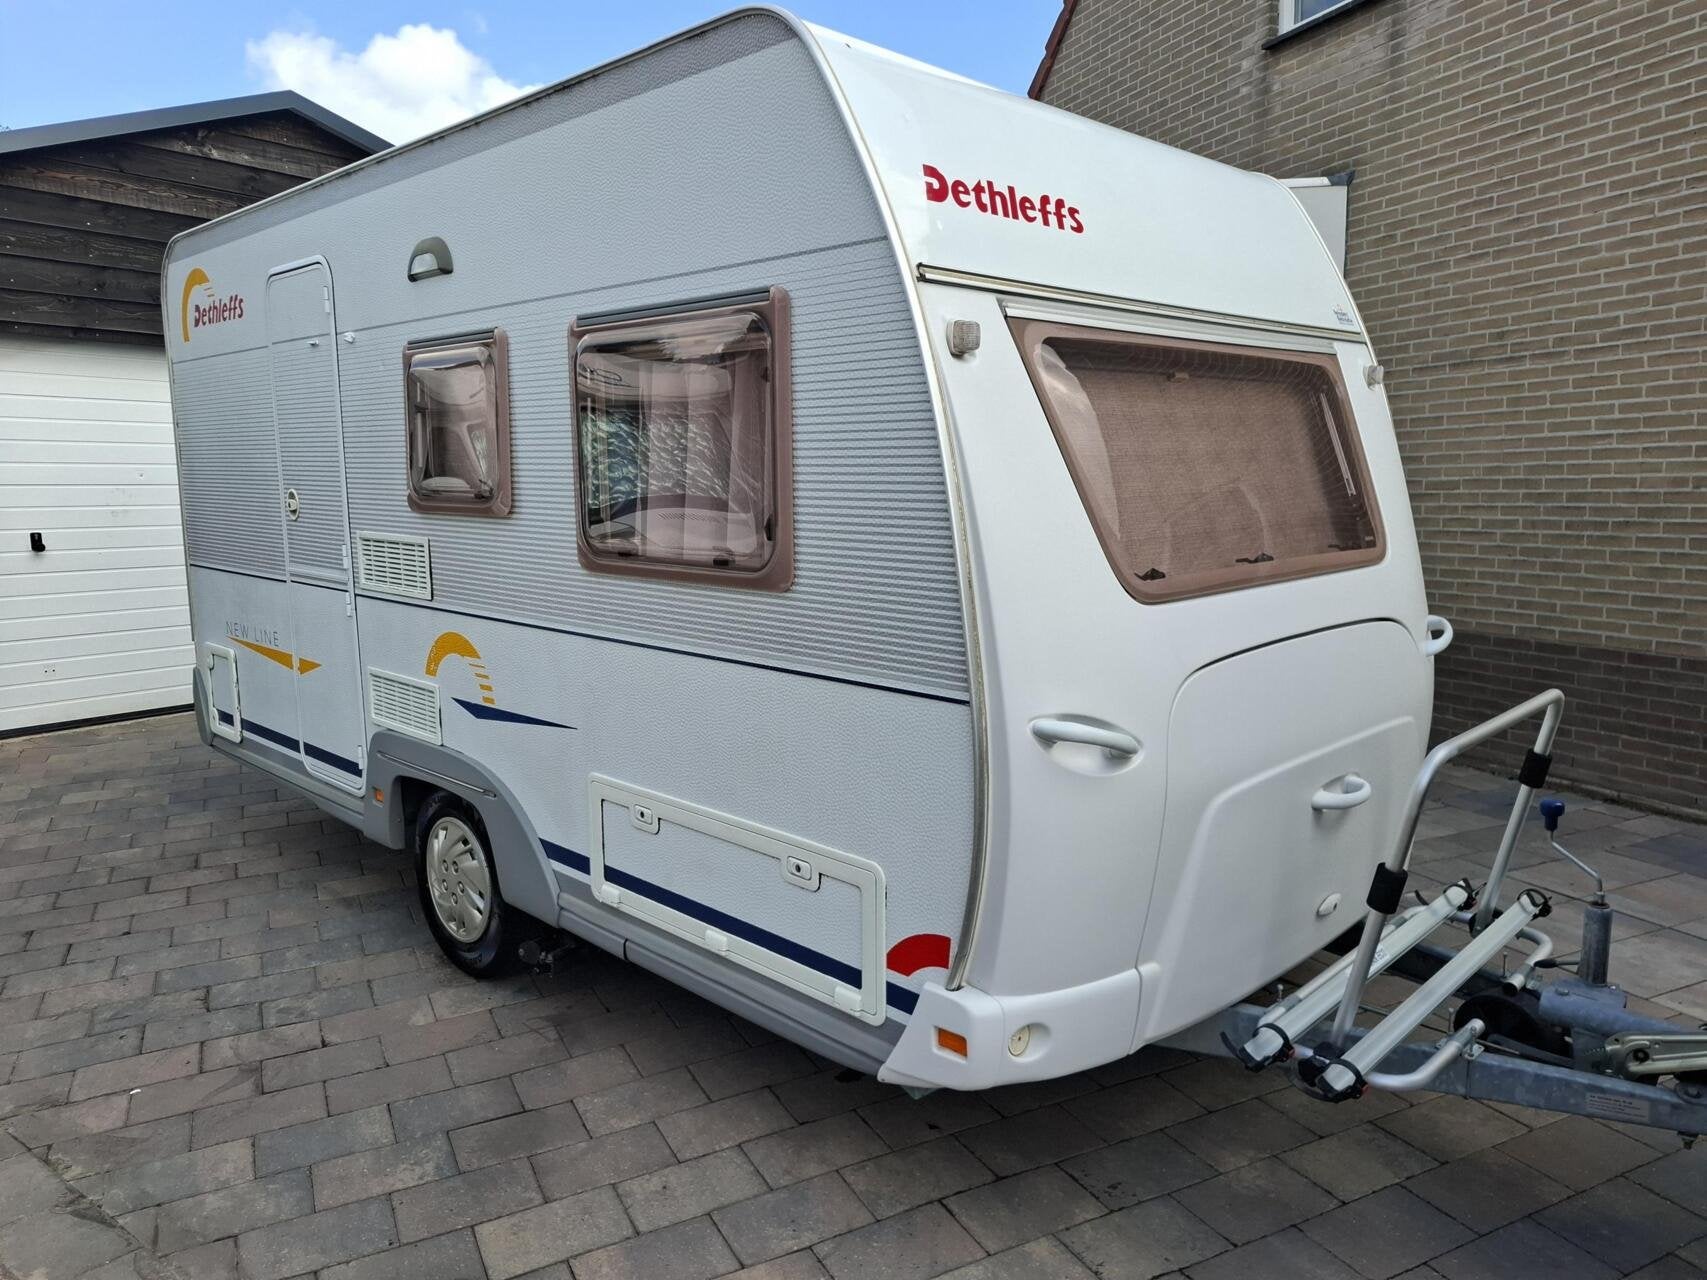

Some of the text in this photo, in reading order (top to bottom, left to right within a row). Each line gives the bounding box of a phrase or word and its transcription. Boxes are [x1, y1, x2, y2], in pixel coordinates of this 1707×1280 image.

[922, 164, 1084, 234] Dethleffs
[194, 294, 244, 328] Dethleffs
[226, 621, 279, 647] NEW LINE
